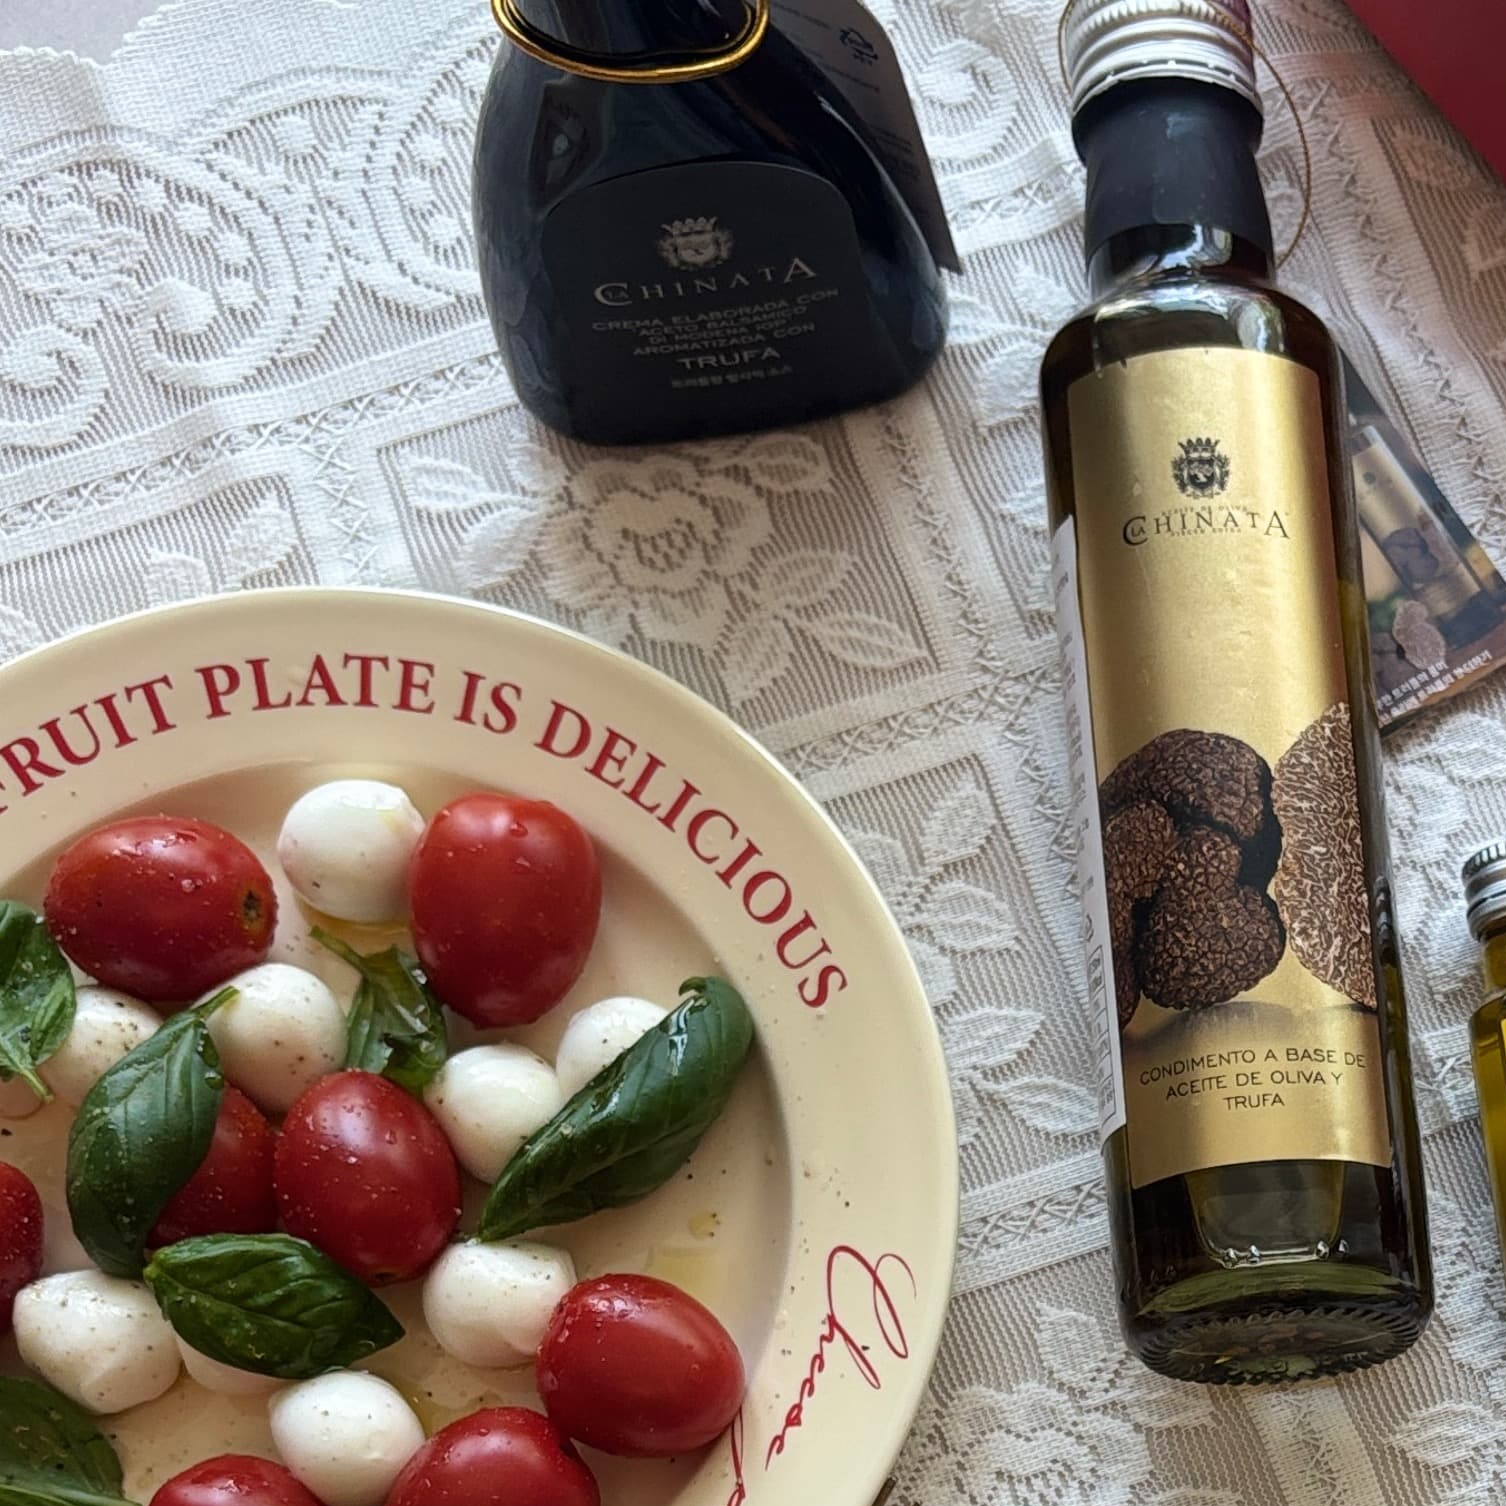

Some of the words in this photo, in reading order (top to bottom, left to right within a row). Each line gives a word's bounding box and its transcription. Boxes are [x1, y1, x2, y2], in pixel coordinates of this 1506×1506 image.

[594, 257, 817, 307] CHINATA
[592, 318, 664, 331] CREMA
[672, 300, 788, 324] ELABORADA
[796, 288, 839, 305] CON
[773, 322, 816, 339] CON
[677, 347, 780, 369] TRUFA
[1122, 510, 1290, 546] CHINATA
[0, 674, 177, 815] RUIT
[194, 652, 436, 720] PLATE
[453, 671, 522, 735] IS
[534, 700, 848, 1009] DELICIOUS
[1139, 1048, 1256, 1086] CONDIMENTO
[1264, 1048, 1278, 1063] A
[1286, 1047, 1337, 1064] BASE
[1344, 1051, 1368, 1069] DE
[1165, 1075, 1228, 1100] ACEITE
[1236, 1071, 1261, 1088] DE
[1270, 1069, 1326, 1086] OLIVA
[1331, 1071, 1343, 1087] Y
[1225, 1091, 1285, 1112] TRUFA
[765, 1245, 917, 1471] Cheese
